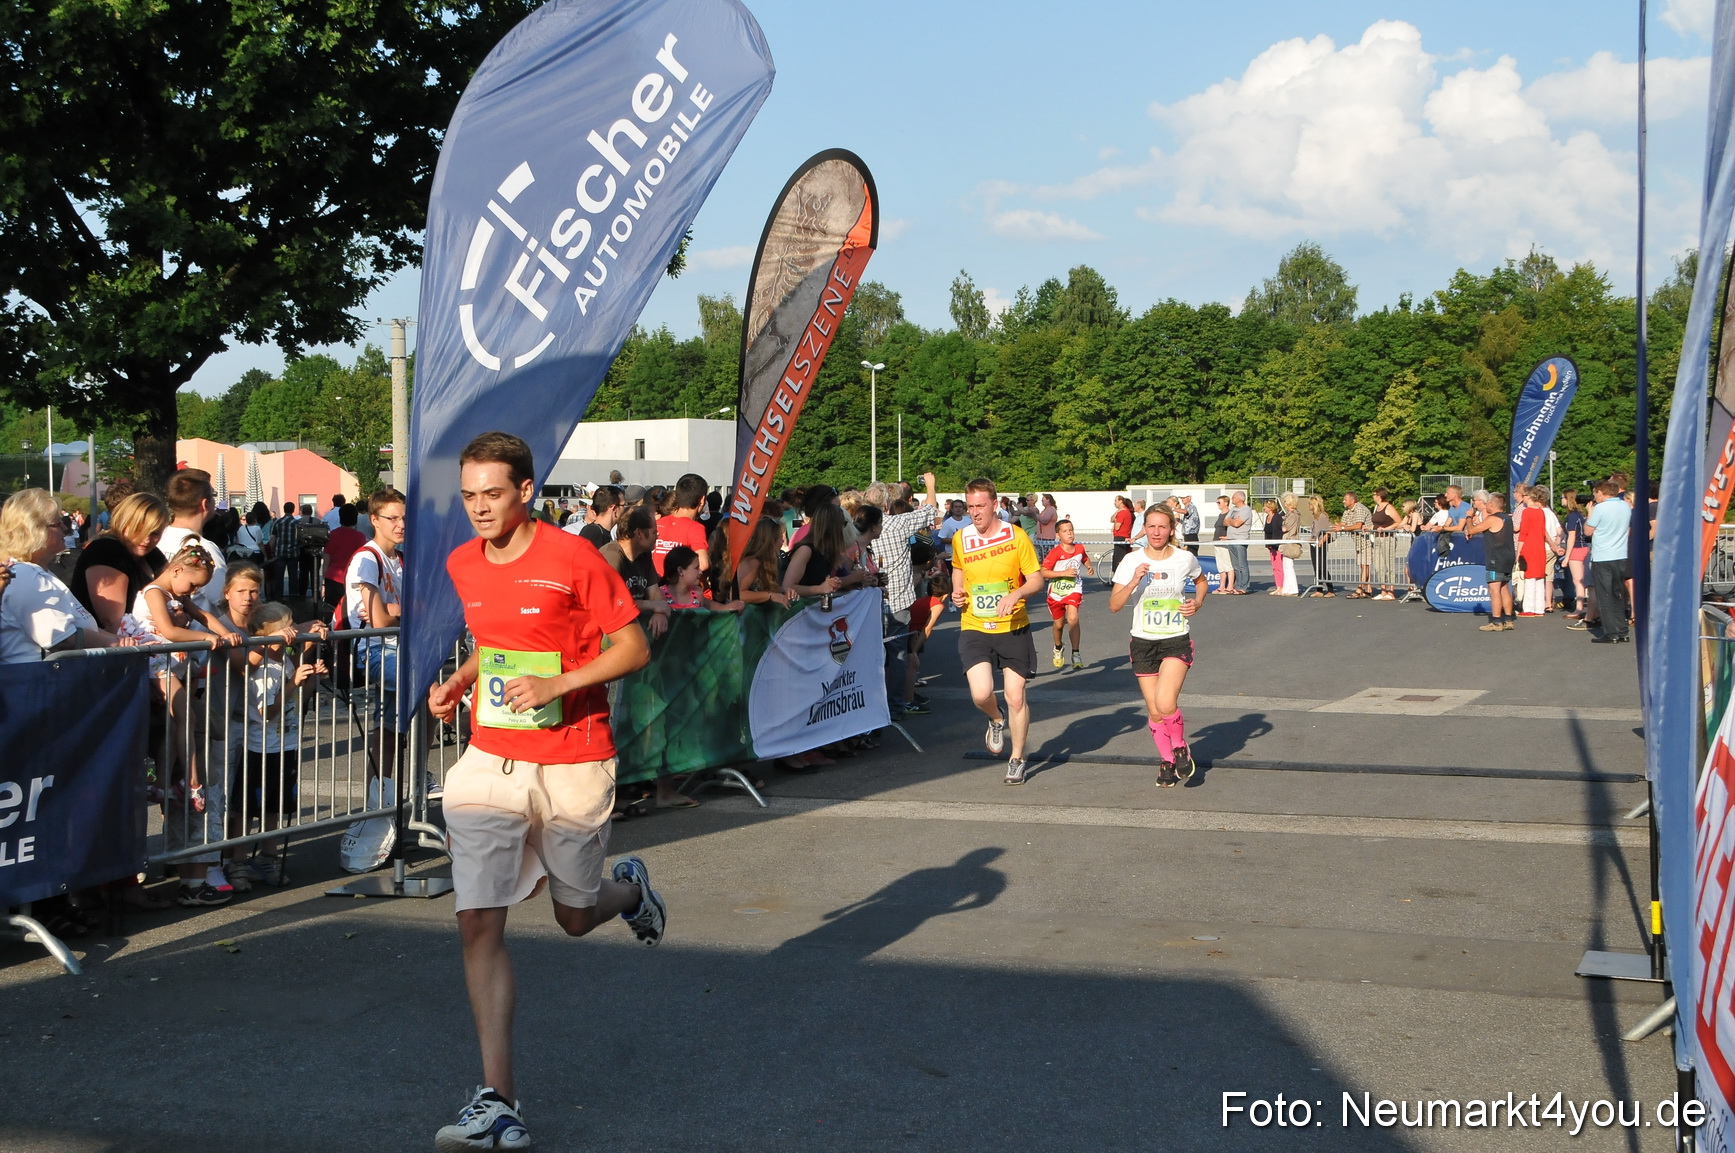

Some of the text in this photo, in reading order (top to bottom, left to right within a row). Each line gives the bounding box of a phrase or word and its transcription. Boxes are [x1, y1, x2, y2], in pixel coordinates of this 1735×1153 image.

[504, 32, 689, 323] Fischer
[572, 82, 714, 316] AUTOMOBILE
[731, 238, 860, 525] WECHSELSZENE.DE
[1512, 391, 1558, 466] Frischmann
[1544, 404, 1557, 424] Druck
[963, 543, 1017, 565] MAX BÖGL
[976, 594, 1004, 610] 828
[1144, 610, 1182, 626] 1014
